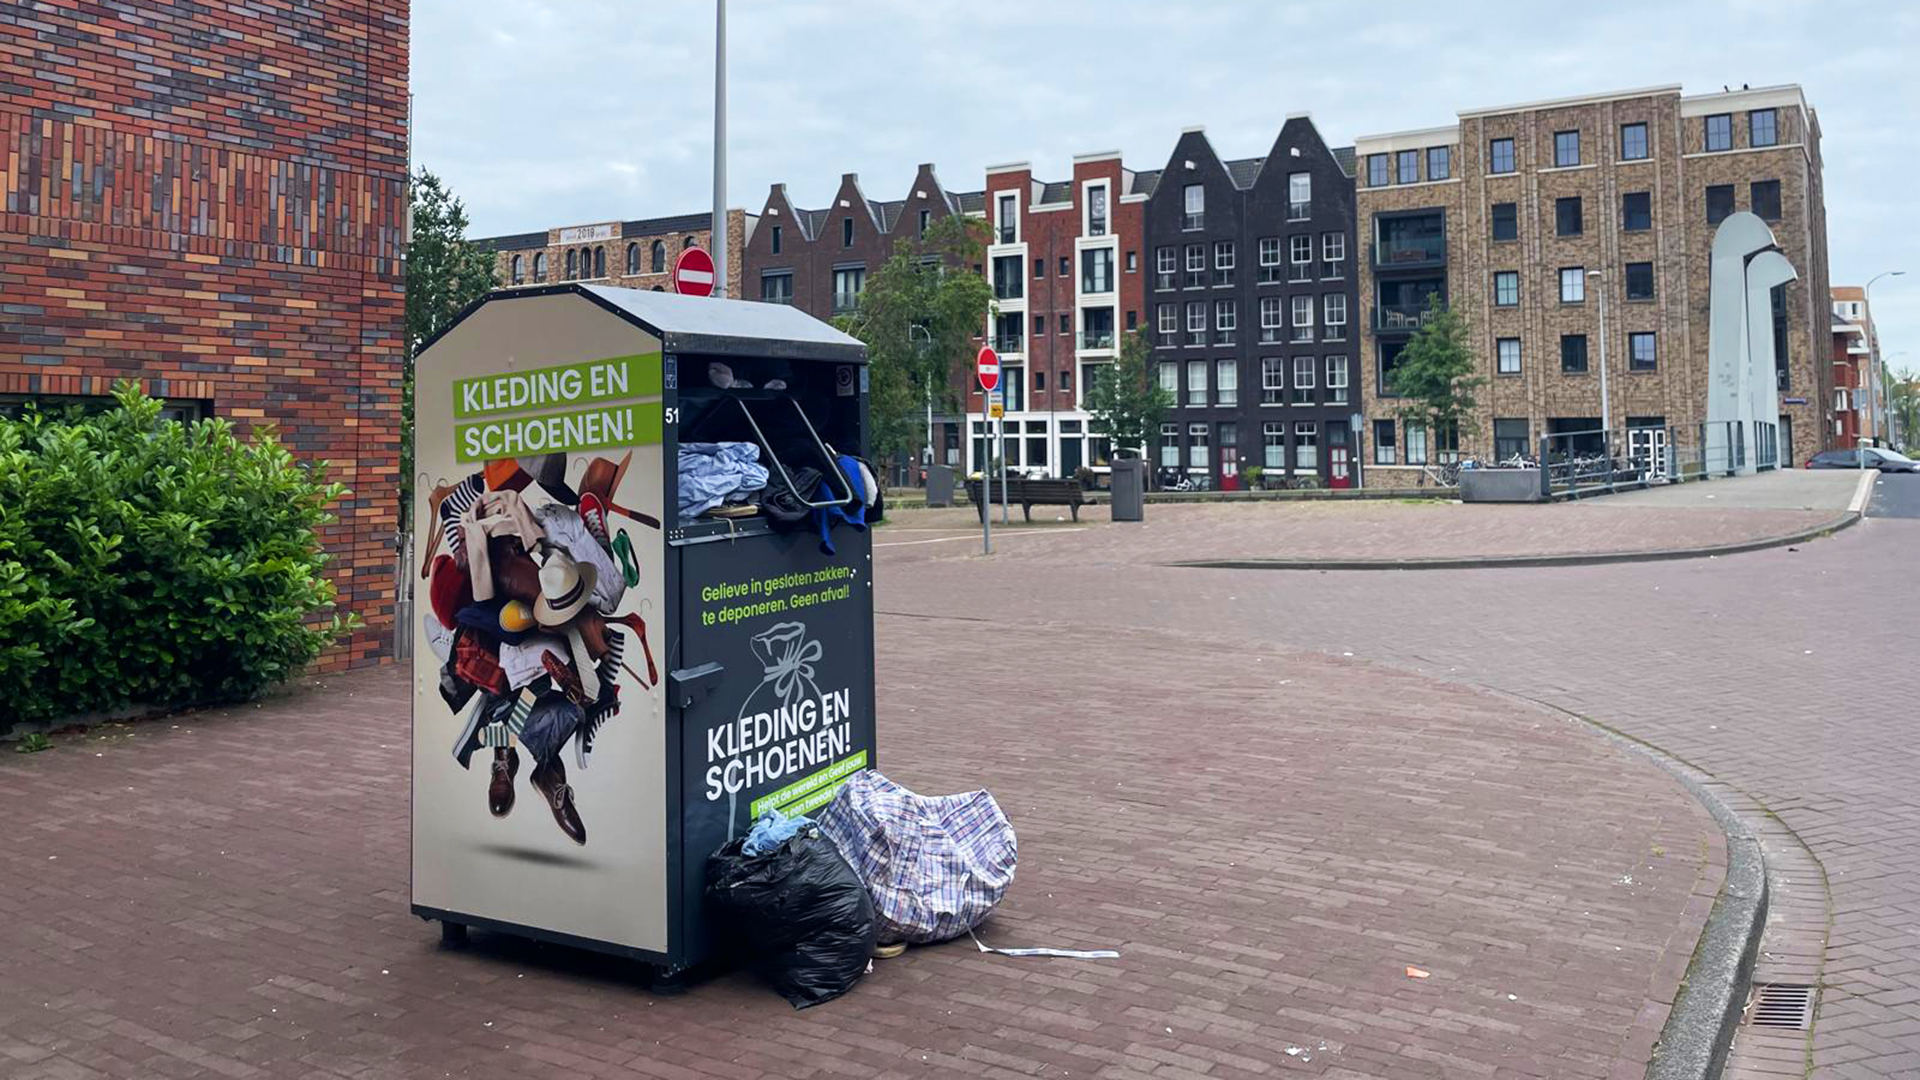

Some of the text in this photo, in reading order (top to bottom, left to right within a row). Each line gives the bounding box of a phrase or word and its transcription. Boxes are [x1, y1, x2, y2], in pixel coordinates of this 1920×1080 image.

[463, 369, 583, 413] KLEDING
[590, 362, 628, 397] EN
[464, 409, 634, 457] SCHOENEN!
[665, 407, 679, 424] 51
[702, 566, 850, 602] Gelieve in gesloten zakken
[702, 584, 850, 626] te deponeren. Geen afval!
[708, 688, 850, 763] KLEDING EN
[706, 722, 851, 801] SCHOENEN!
[780, 790, 792, 801] de
[792, 774, 818, 795] wereld
[818, 773, 828, 783] en
[829, 761, 846, 778] Geef
[845, 756, 863, 774] jouw
[789, 803, 805, 817] een
[805, 787, 833, 809] tweede
